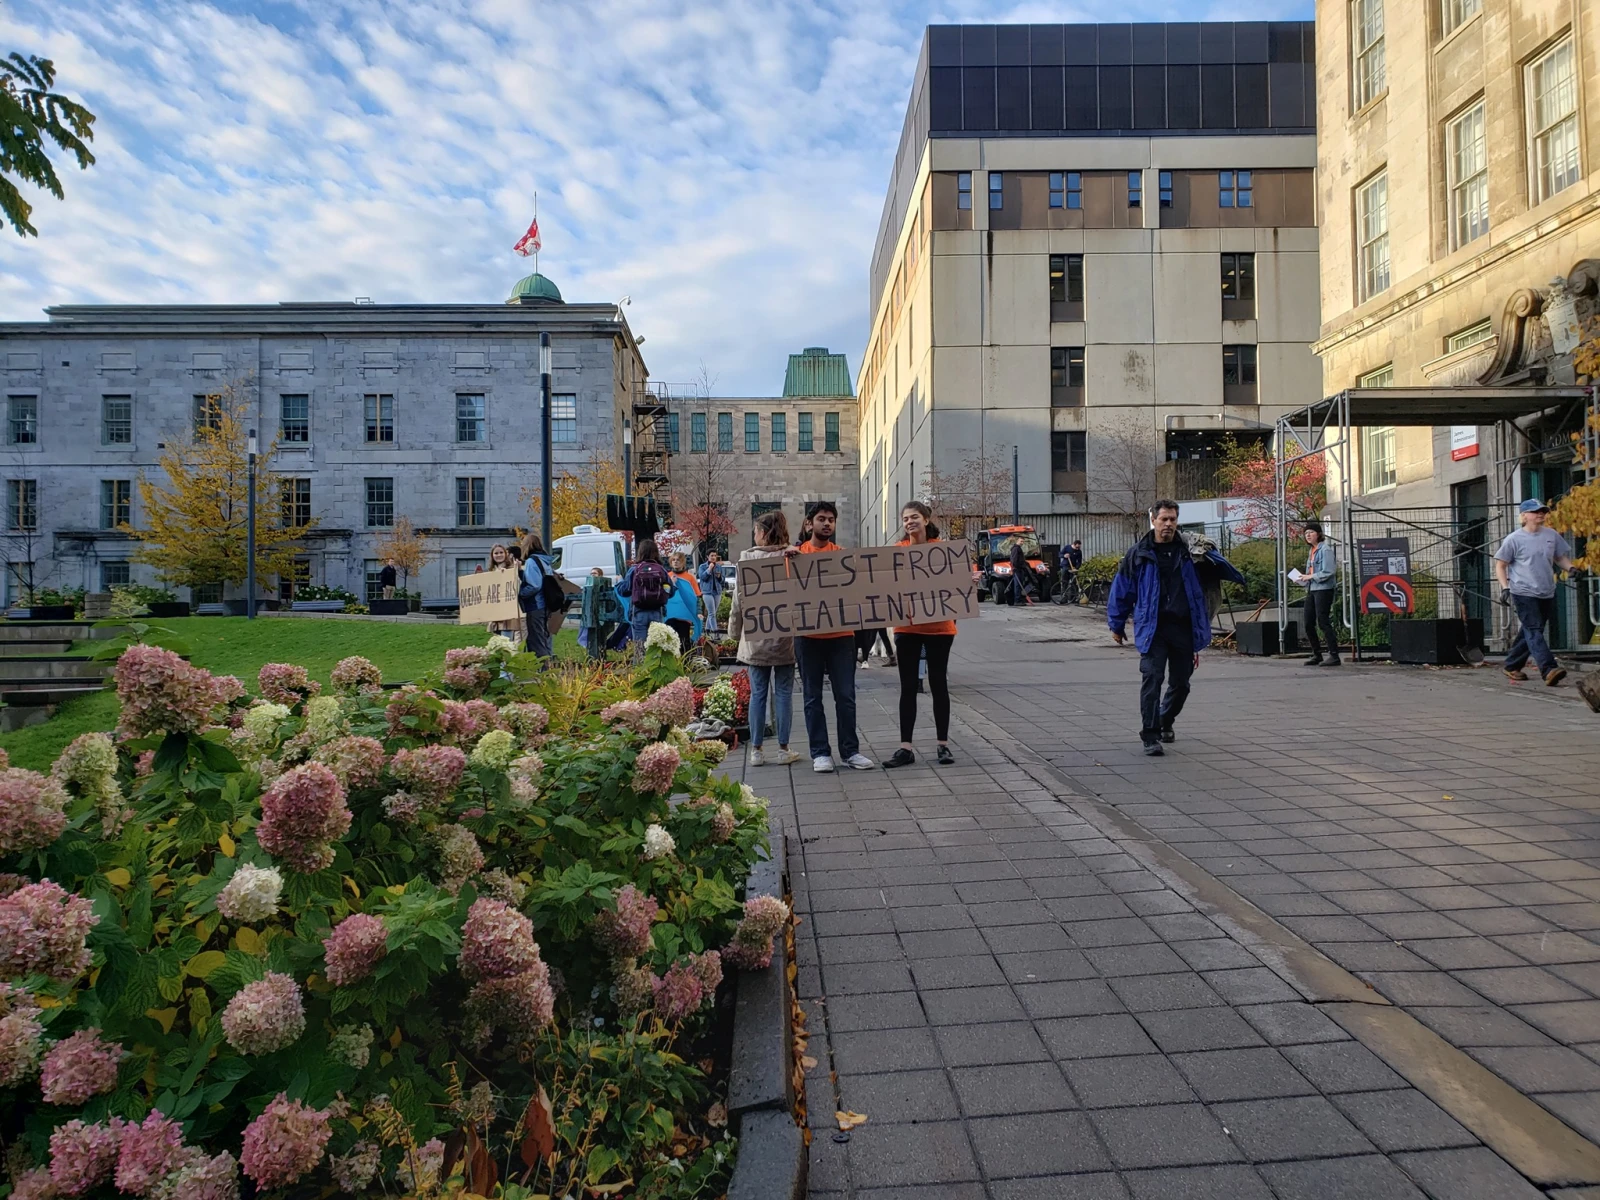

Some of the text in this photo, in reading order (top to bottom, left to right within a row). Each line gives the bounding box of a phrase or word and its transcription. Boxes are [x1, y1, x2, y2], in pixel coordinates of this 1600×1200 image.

[742, 545, 972, 597] DIVEST FROM
[460, 585, 482, 609] OCEANS
[486, 583, 501, 604] ARE
[744, 586, 973, 634] SOCIAL INJURY
